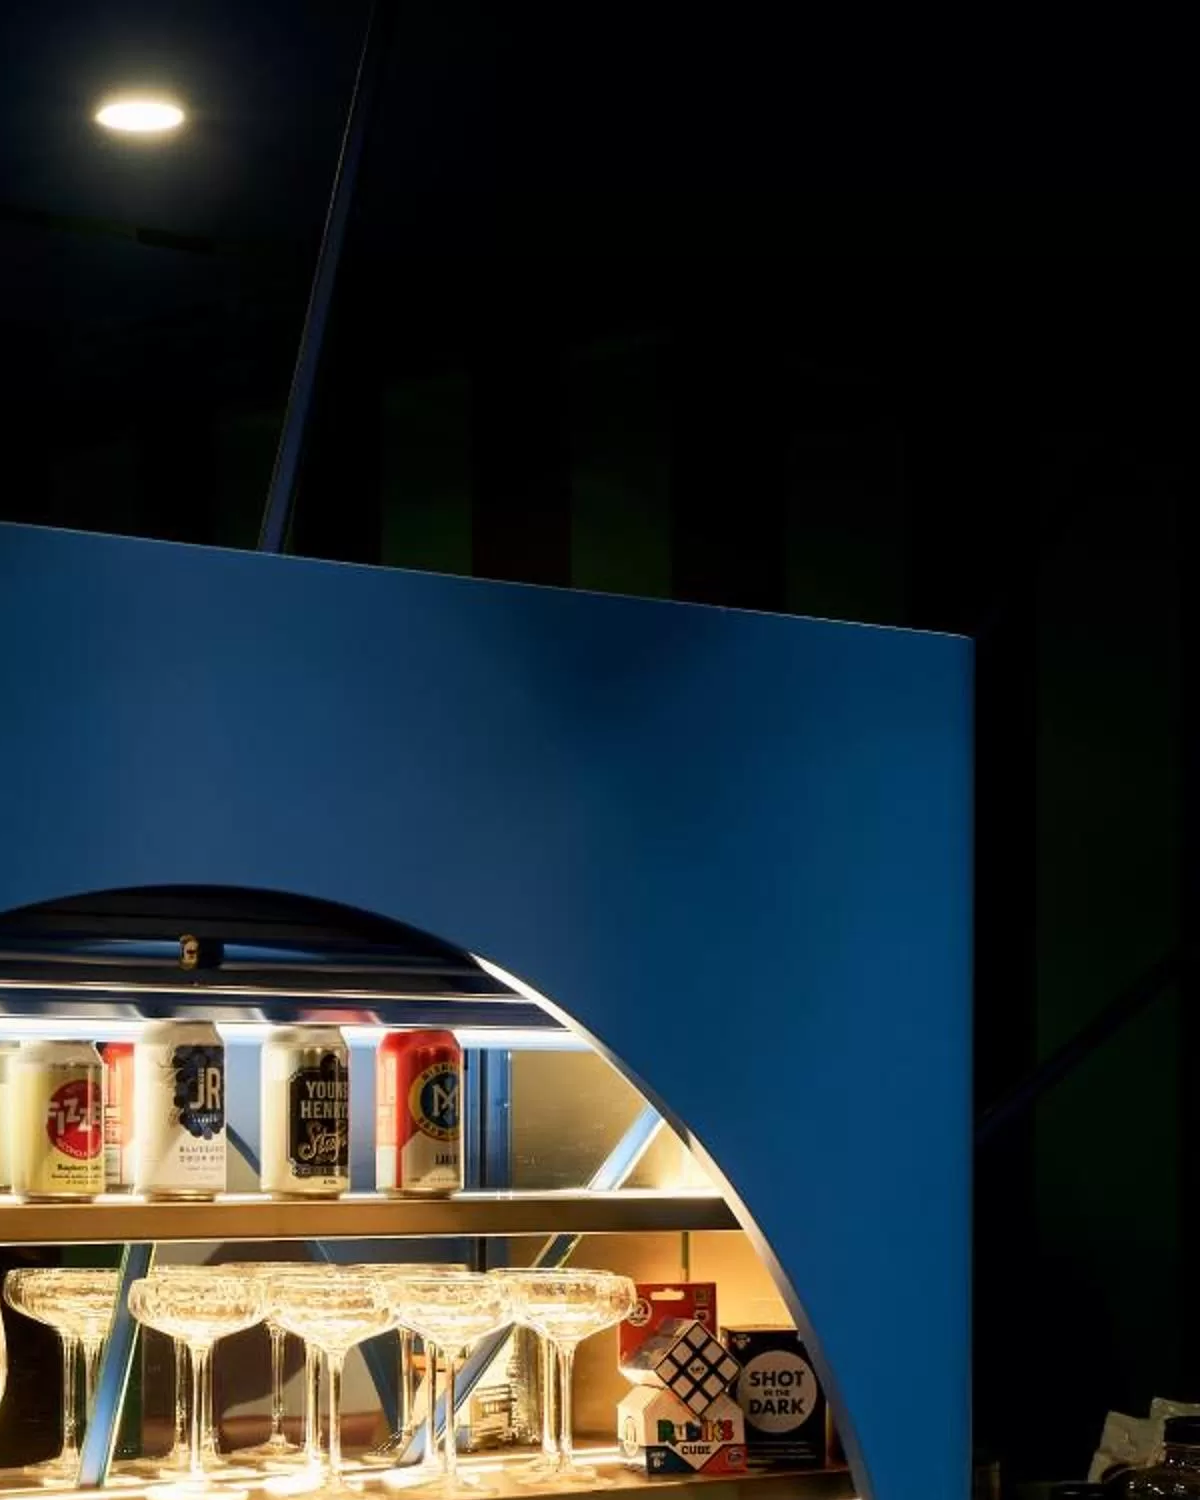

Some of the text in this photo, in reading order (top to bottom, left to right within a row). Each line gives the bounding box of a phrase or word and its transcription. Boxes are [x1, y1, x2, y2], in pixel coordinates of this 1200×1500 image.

[749, 1370, 805, 1388] SHOT
[775, 1389, 791, 1397] THE
[749, 1398, 805, 1416] DARK
